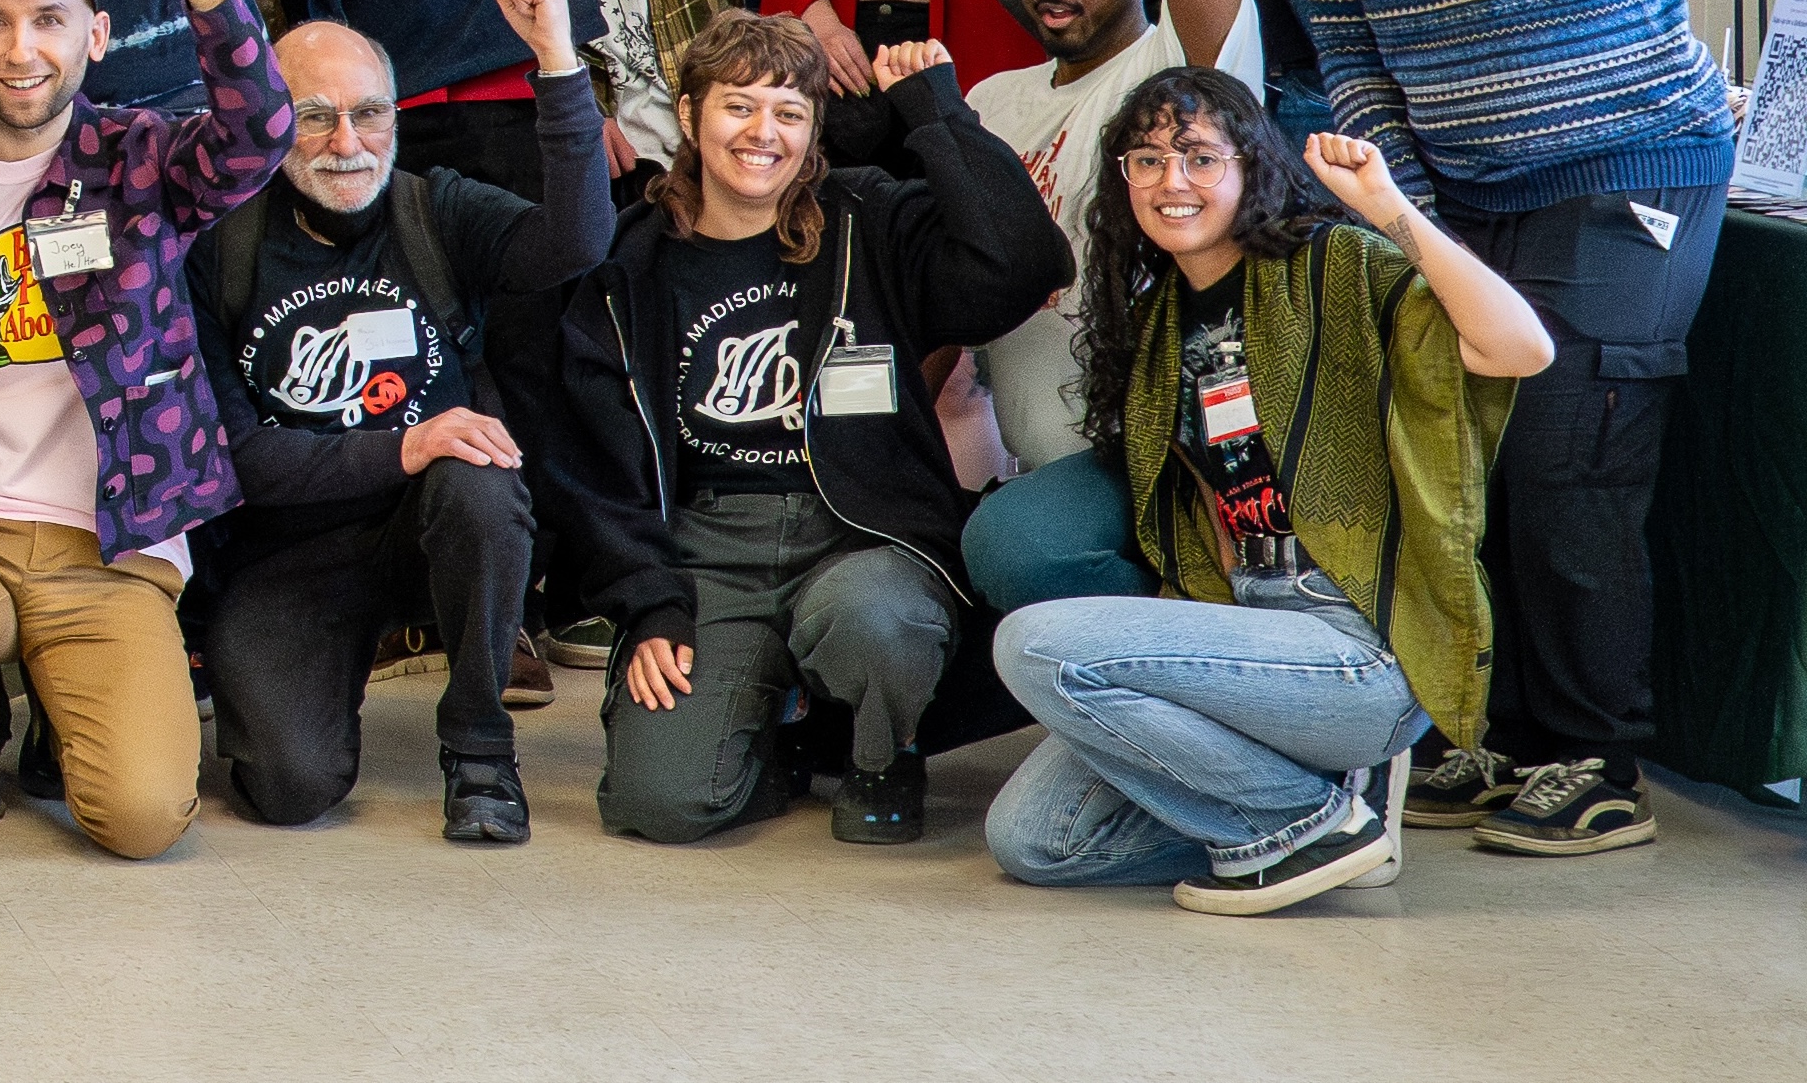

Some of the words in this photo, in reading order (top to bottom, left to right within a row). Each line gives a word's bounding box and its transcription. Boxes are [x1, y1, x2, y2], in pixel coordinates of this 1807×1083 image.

[48, 240, 85, 257] Joey
[263, 276, 356, 327] MADISON
[686, 282, 775, 343] MADISON
